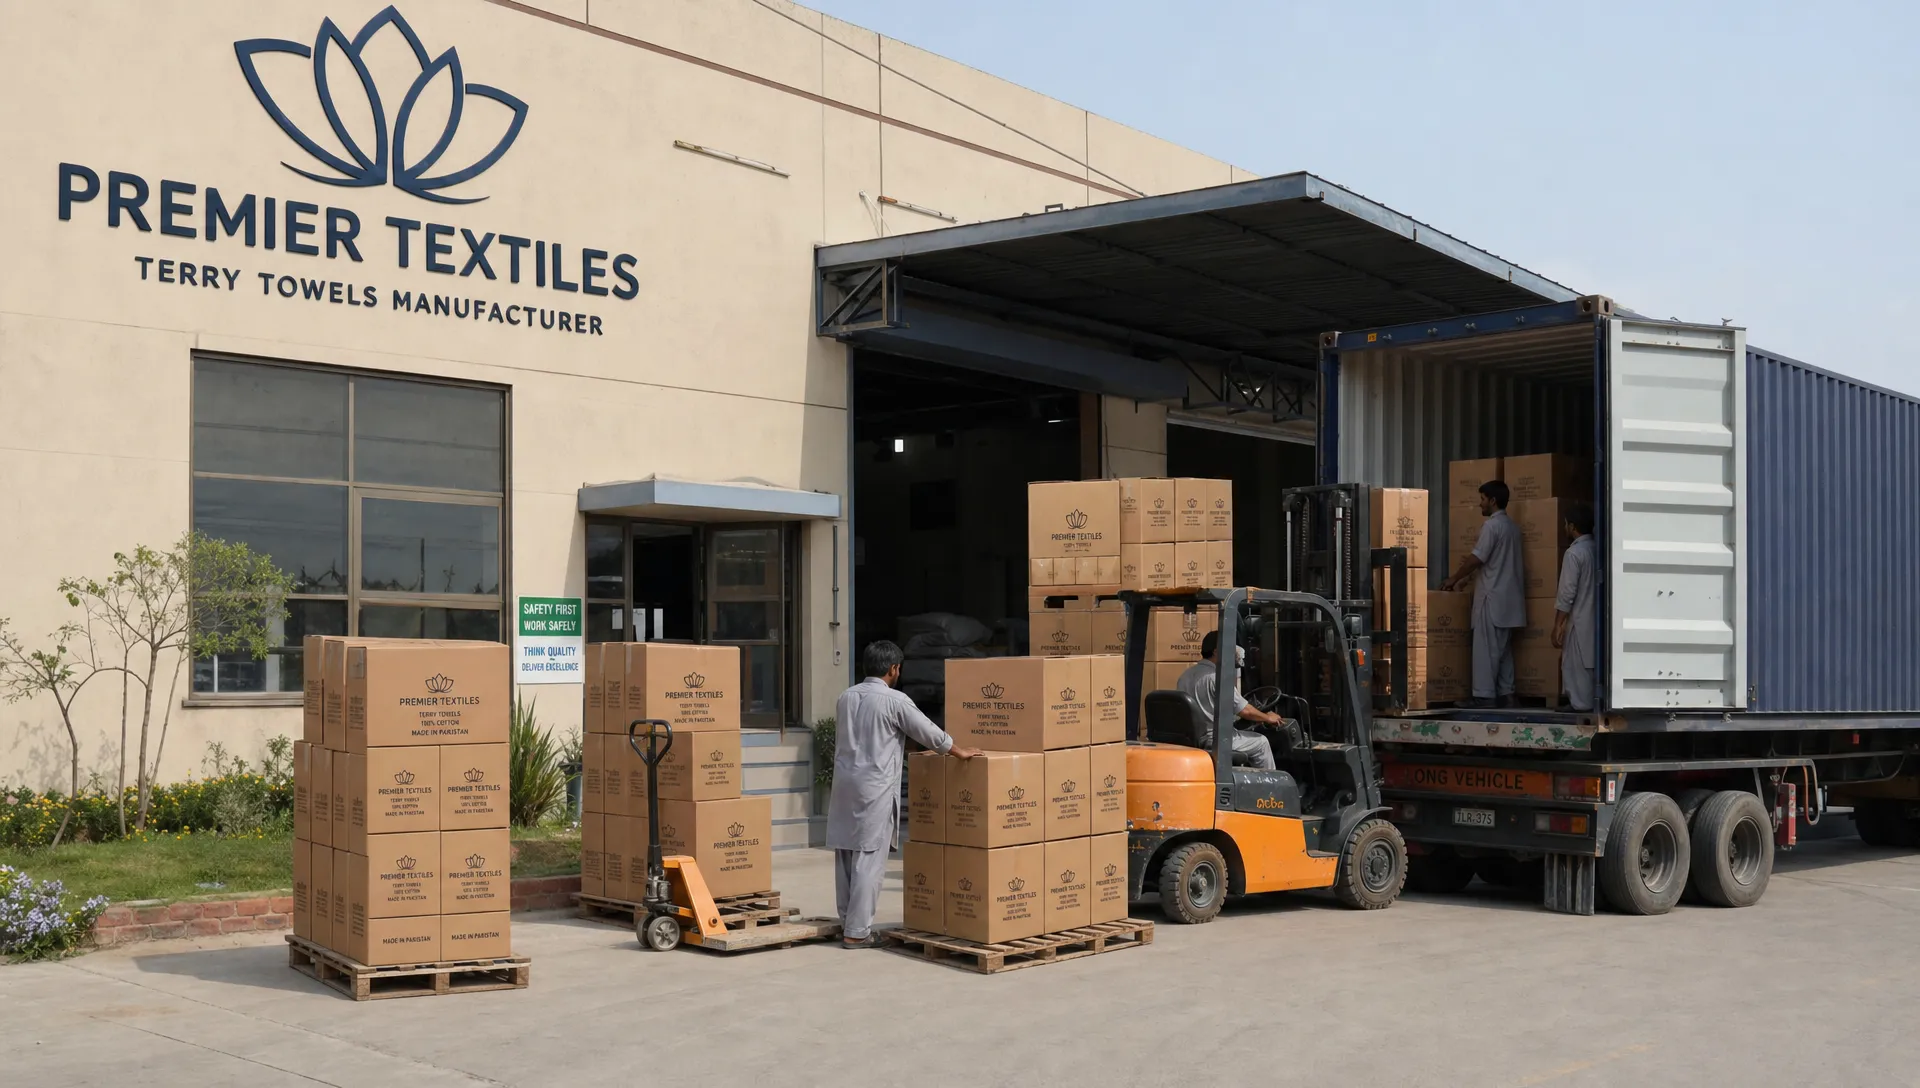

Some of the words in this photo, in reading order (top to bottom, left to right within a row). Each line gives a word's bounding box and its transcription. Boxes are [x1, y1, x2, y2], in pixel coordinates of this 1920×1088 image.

[58, 161, 363, 262] PREMIER
[385, 216, 639, 300] TEXTILES
[135, 255, 241, 290] TERRY
[258, 272, 378, 307] TOWELS
[392, 291, 603, 336] MANUFACTURER
[524, 603, 553, 615] SAFETY
[556, 604, 577, 615] FIRST
[524, 620, 546, 631] WORK
[549, 620, 576, 631] SAFELY
[524, 646, 545, 656] THINK
[548, 646, 576, 656] QUALITY
[522, 662, 544, 671] DELIVER
[546, 662, 578, 671] EXCELLENCE
[665, 691, 693, 699] PREMIER
[400, 697, 438, 706] PREMIER
[440, 696, 480, 705] TEXTILES
[993, 702, 1025, 710] TEXTILES
[1405, 767, 1448, 785] ONG
[1454, 769, 1524, 790] VEHICLE
